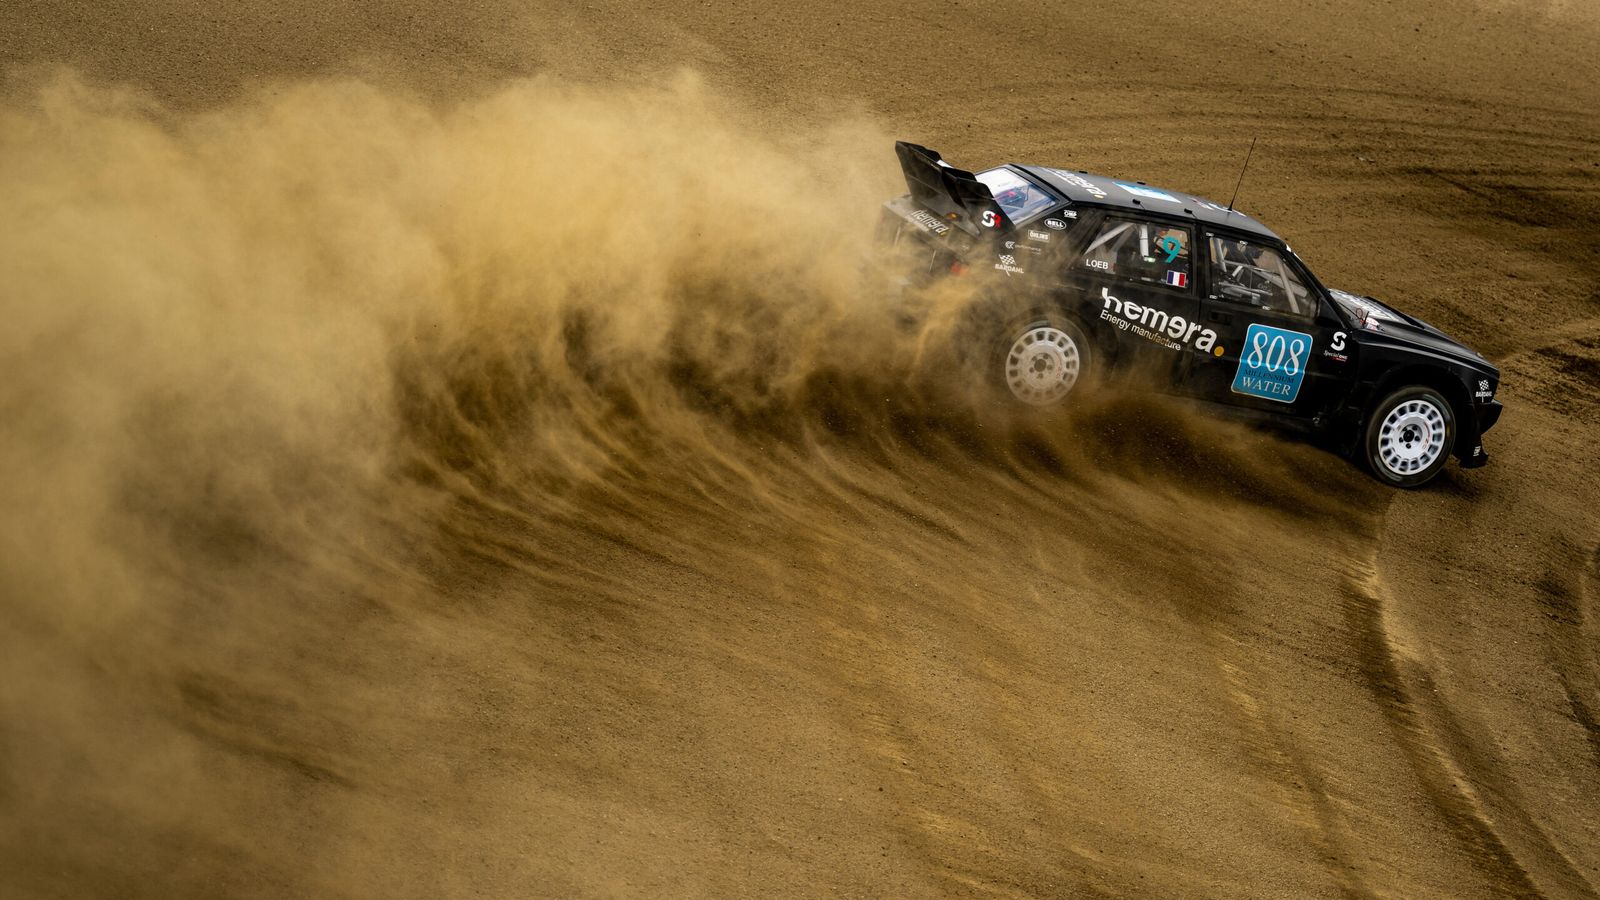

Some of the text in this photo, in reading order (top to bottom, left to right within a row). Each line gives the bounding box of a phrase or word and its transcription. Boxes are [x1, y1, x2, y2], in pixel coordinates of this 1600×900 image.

[1047, 220, 1064, 228] BELL
[1162, 236, 1181, 263] 9
[995, 263, 1024, 274] BARDAHL
[1085, 258, 1109, 270] LOEB
[1100, 309, 1181, 351] Energy manufacture
[1247, 331, 1305, 376] 808
[1244, 368, 1295, 384] MILLENNIUM
[1242, 376, 1291, 396] WATER
